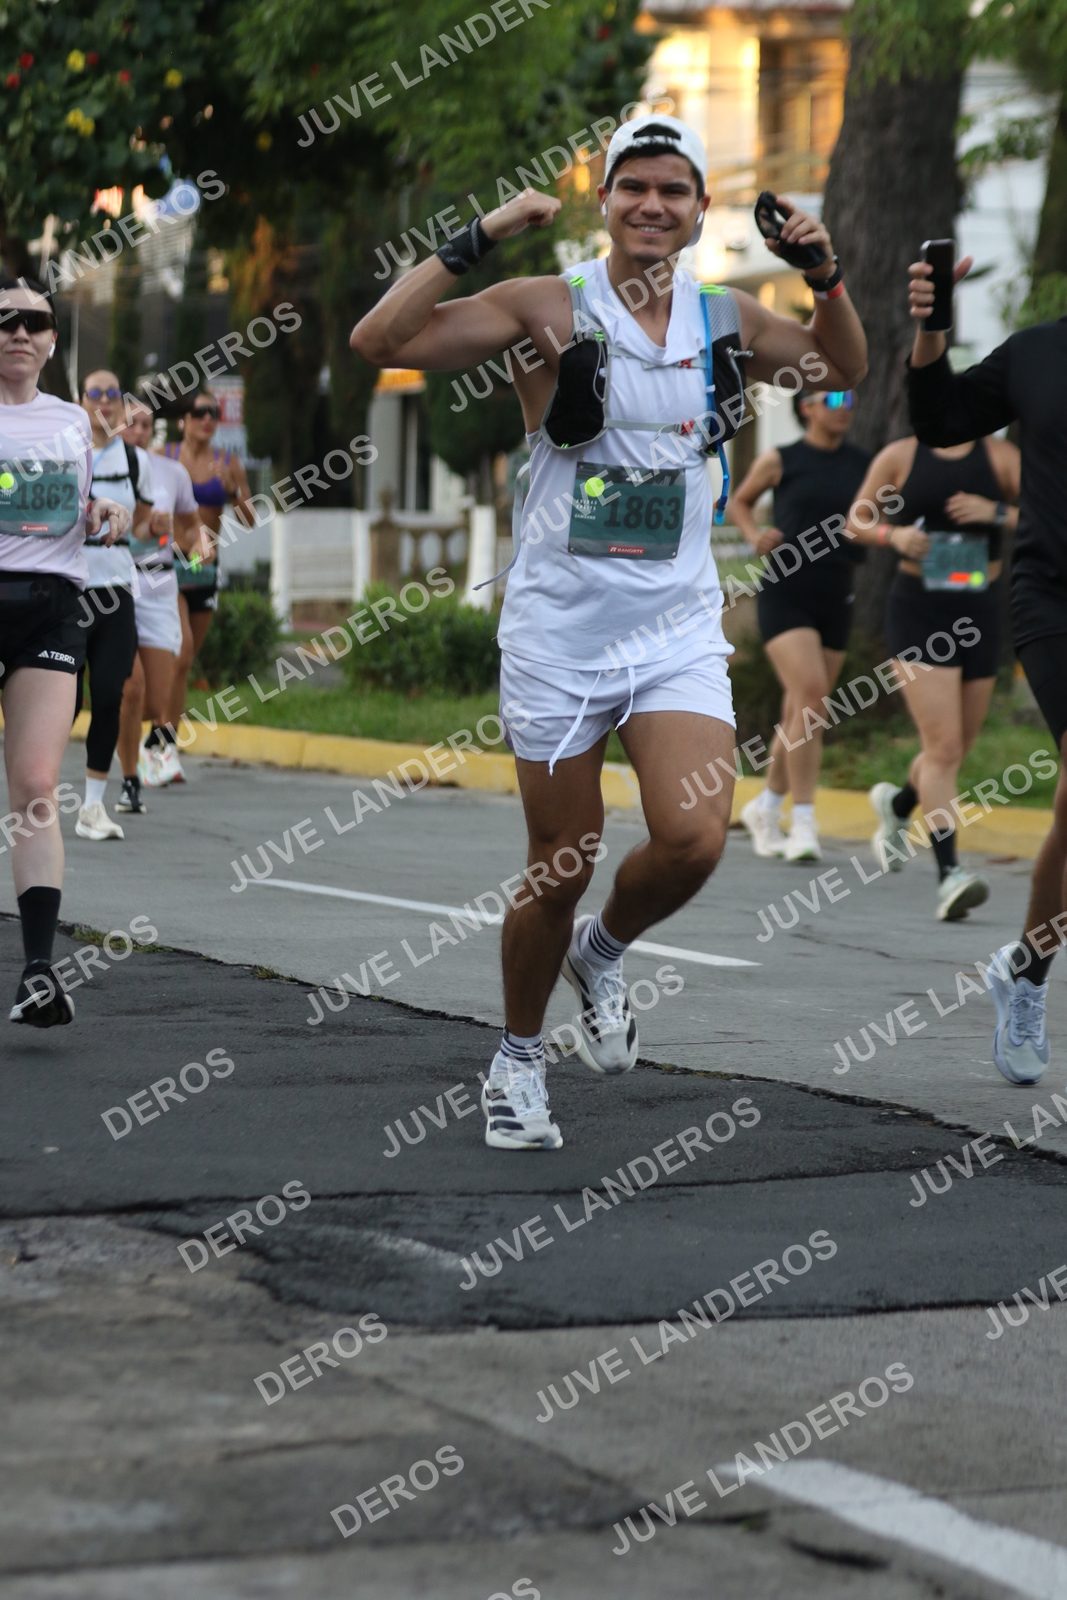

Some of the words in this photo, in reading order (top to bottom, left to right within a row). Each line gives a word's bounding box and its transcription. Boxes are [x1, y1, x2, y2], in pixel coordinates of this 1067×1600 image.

[16, 483, 75, 511] 1862
[604, 496, 680, 530] 1863
[50, 651, 75, 666] TERREX
